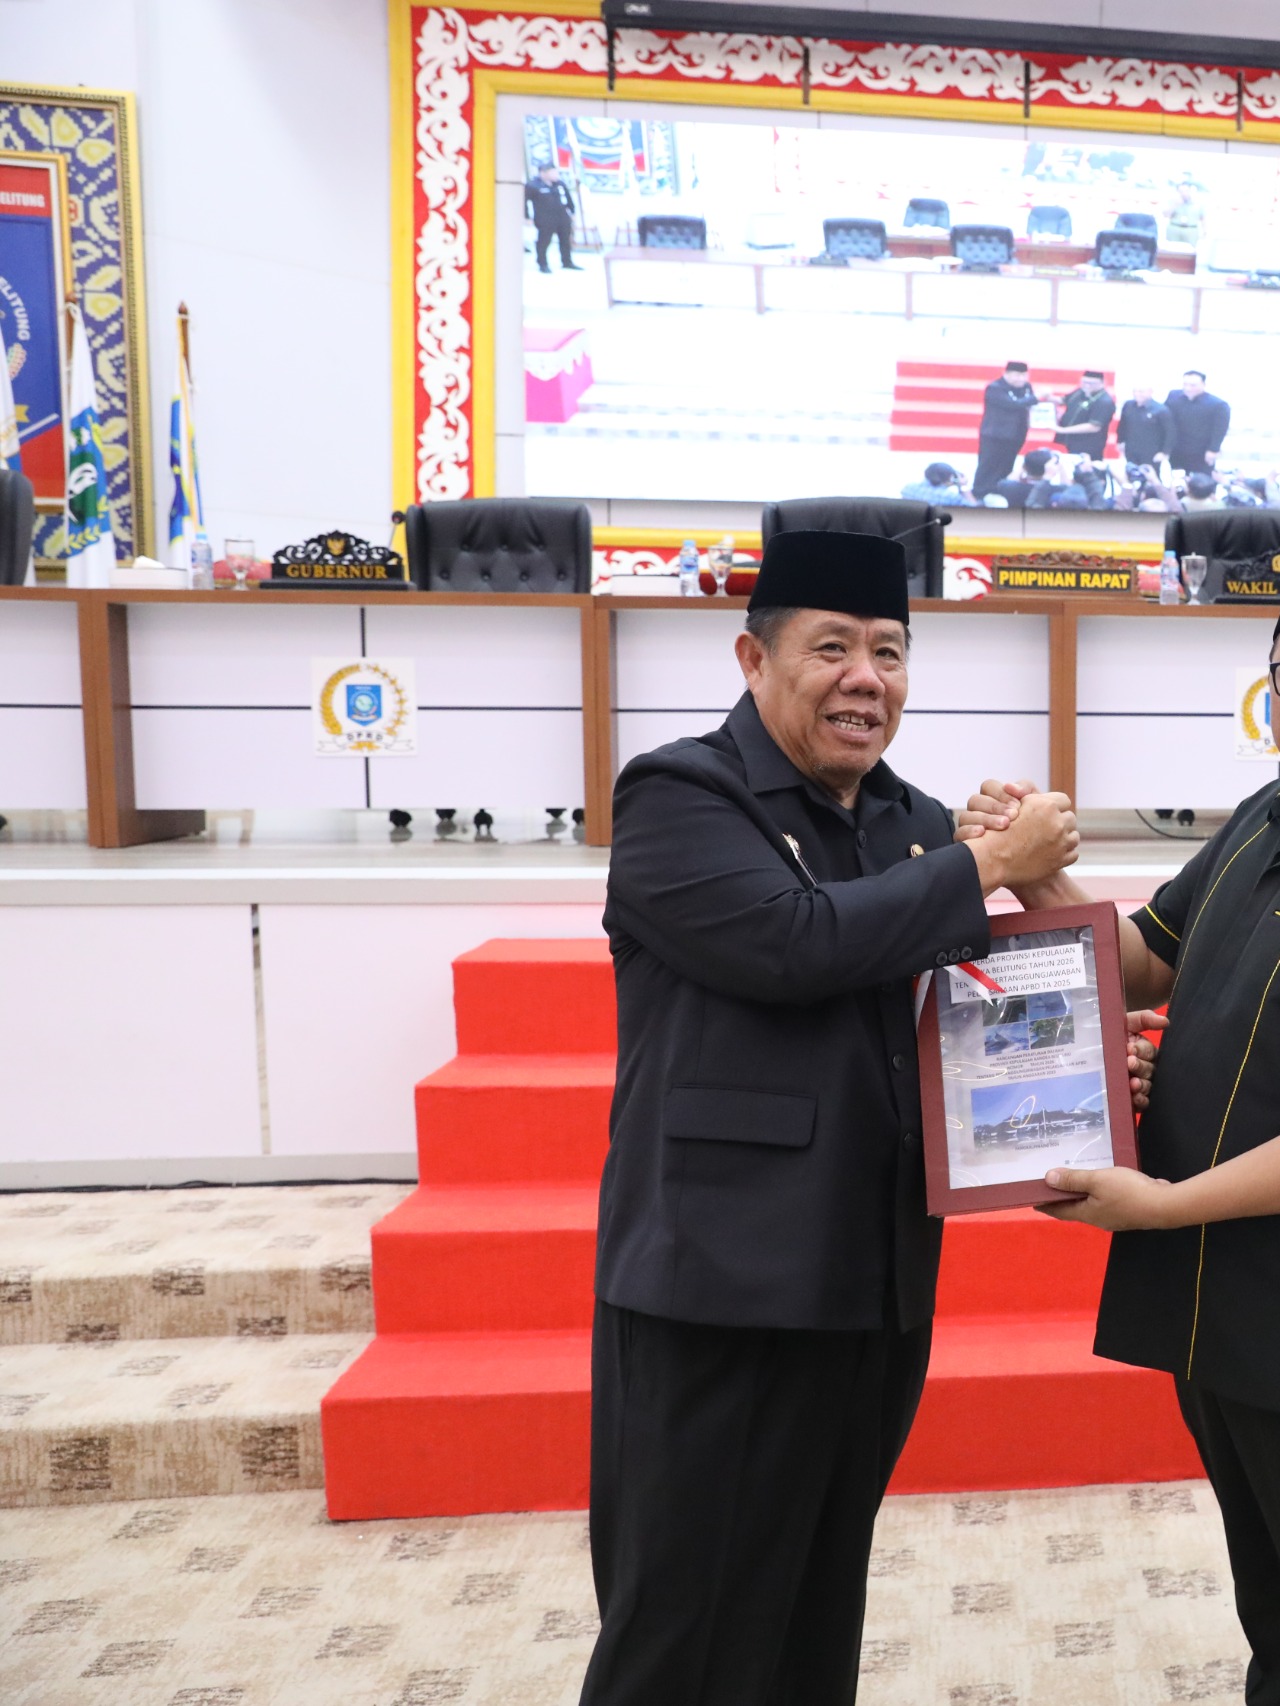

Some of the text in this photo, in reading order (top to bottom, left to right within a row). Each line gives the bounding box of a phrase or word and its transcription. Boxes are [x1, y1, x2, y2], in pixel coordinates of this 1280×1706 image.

[0, 191, 46, 208] ELITUNG
[0, 275, 31, 341] ELITUNG
[286, 564, 388, 579] GUBERNUR
[999, 570, 1130, 589] PIMPINAN RAPAT
[1226, 581, 1278, 595] WAKIL
[346, 731, 383, 742] DPRD
[996, 953, 1030, 962] PROVINSI
[1032, 947, 1076, 958] KEPULAUAN
[991, 963, 1027, 974] BELITUNG
[1029, 960, 1055, 969] TAHUN
[1056, 957, 1075, 966] 2026
[1020, 983, 1040, 991] APBD
[1042, 981, 1052, 989] TA
[1053, 979, 1071, 987] 2025
